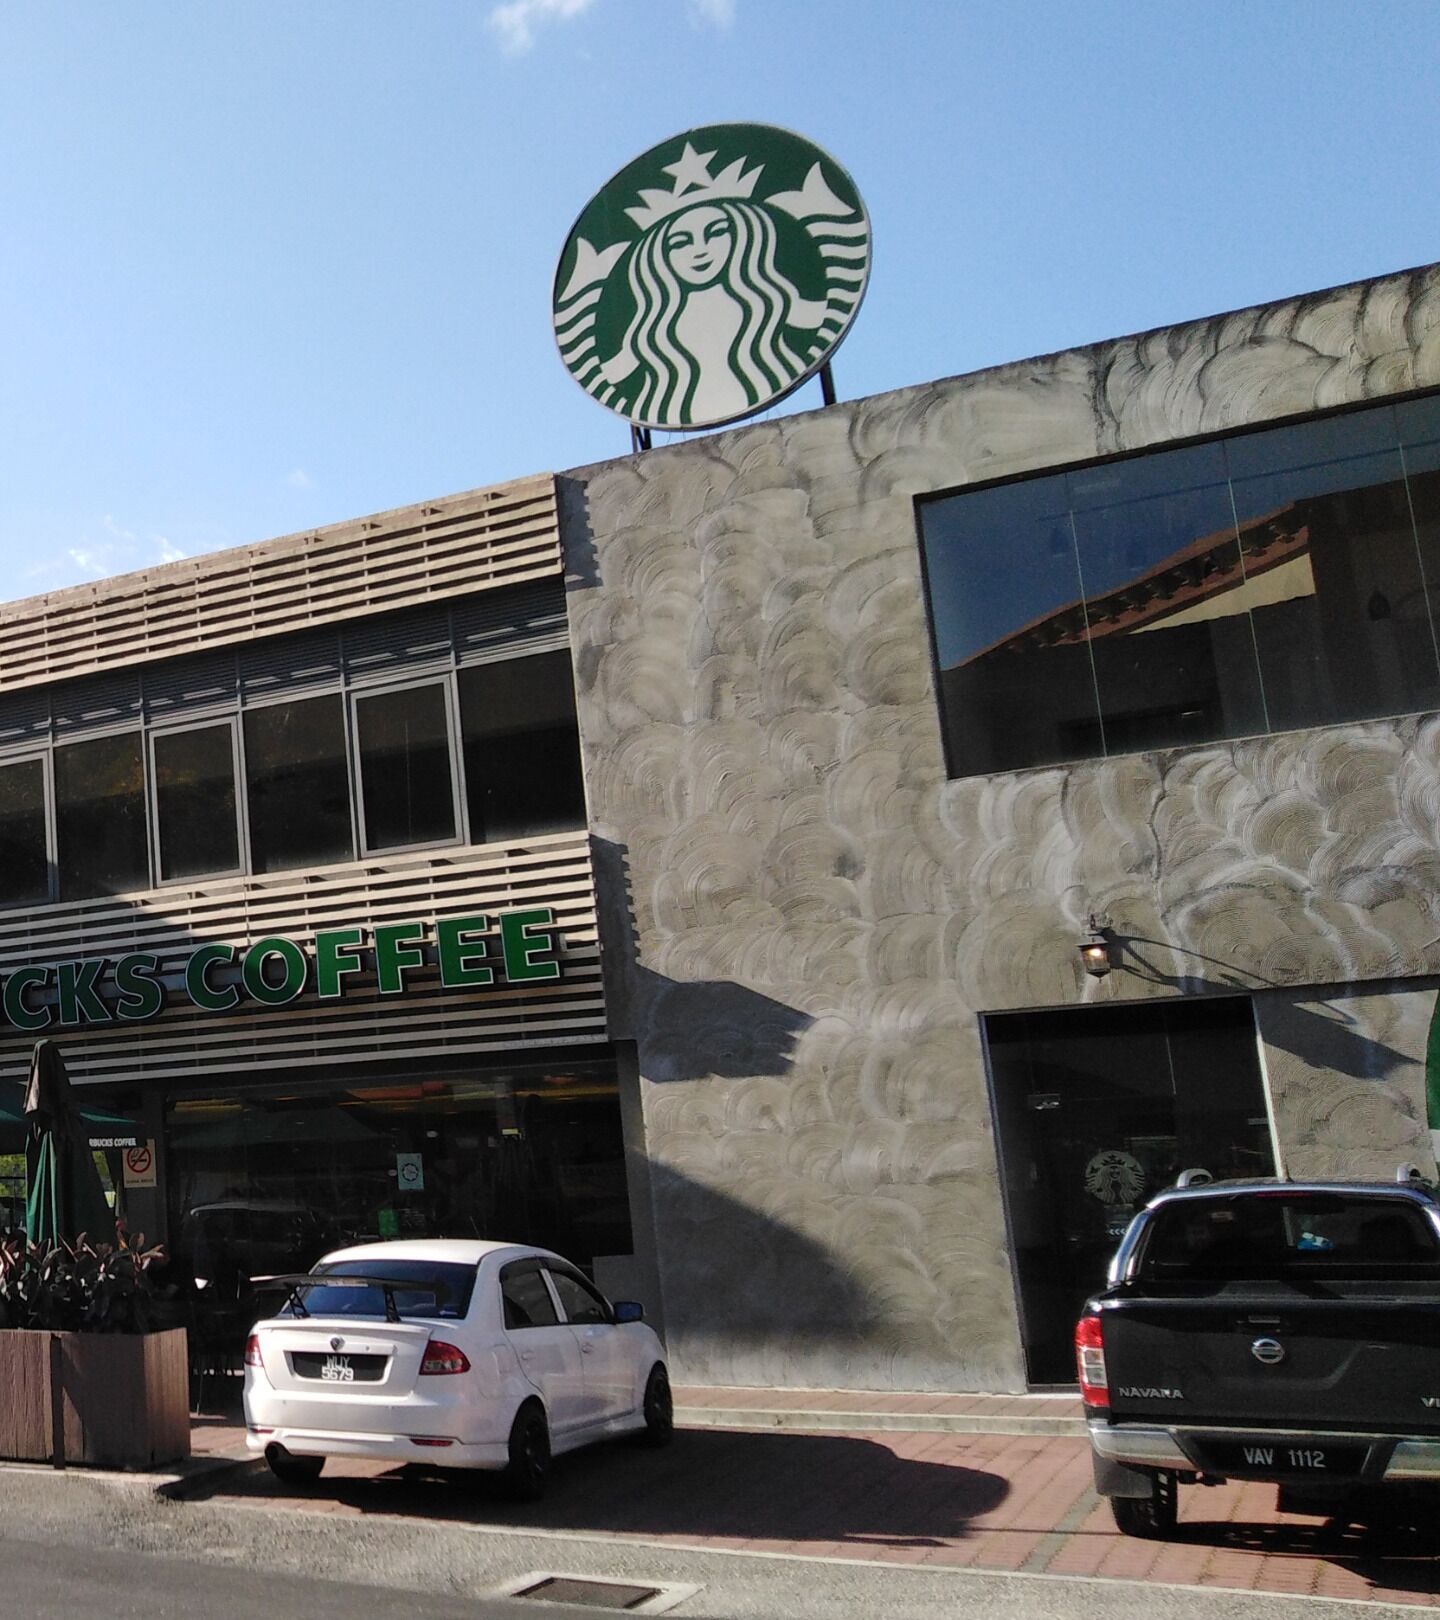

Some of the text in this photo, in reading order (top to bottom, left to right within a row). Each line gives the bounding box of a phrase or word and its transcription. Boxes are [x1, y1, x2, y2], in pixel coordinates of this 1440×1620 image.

[184, 907, 560, 1011] COFFEE
[114, 1137, 137, 1147] COFFEE
[1119, 1386, 1185, 1399] NAVARA
[1242, 1447, 1327, 1468] VAV 1112
